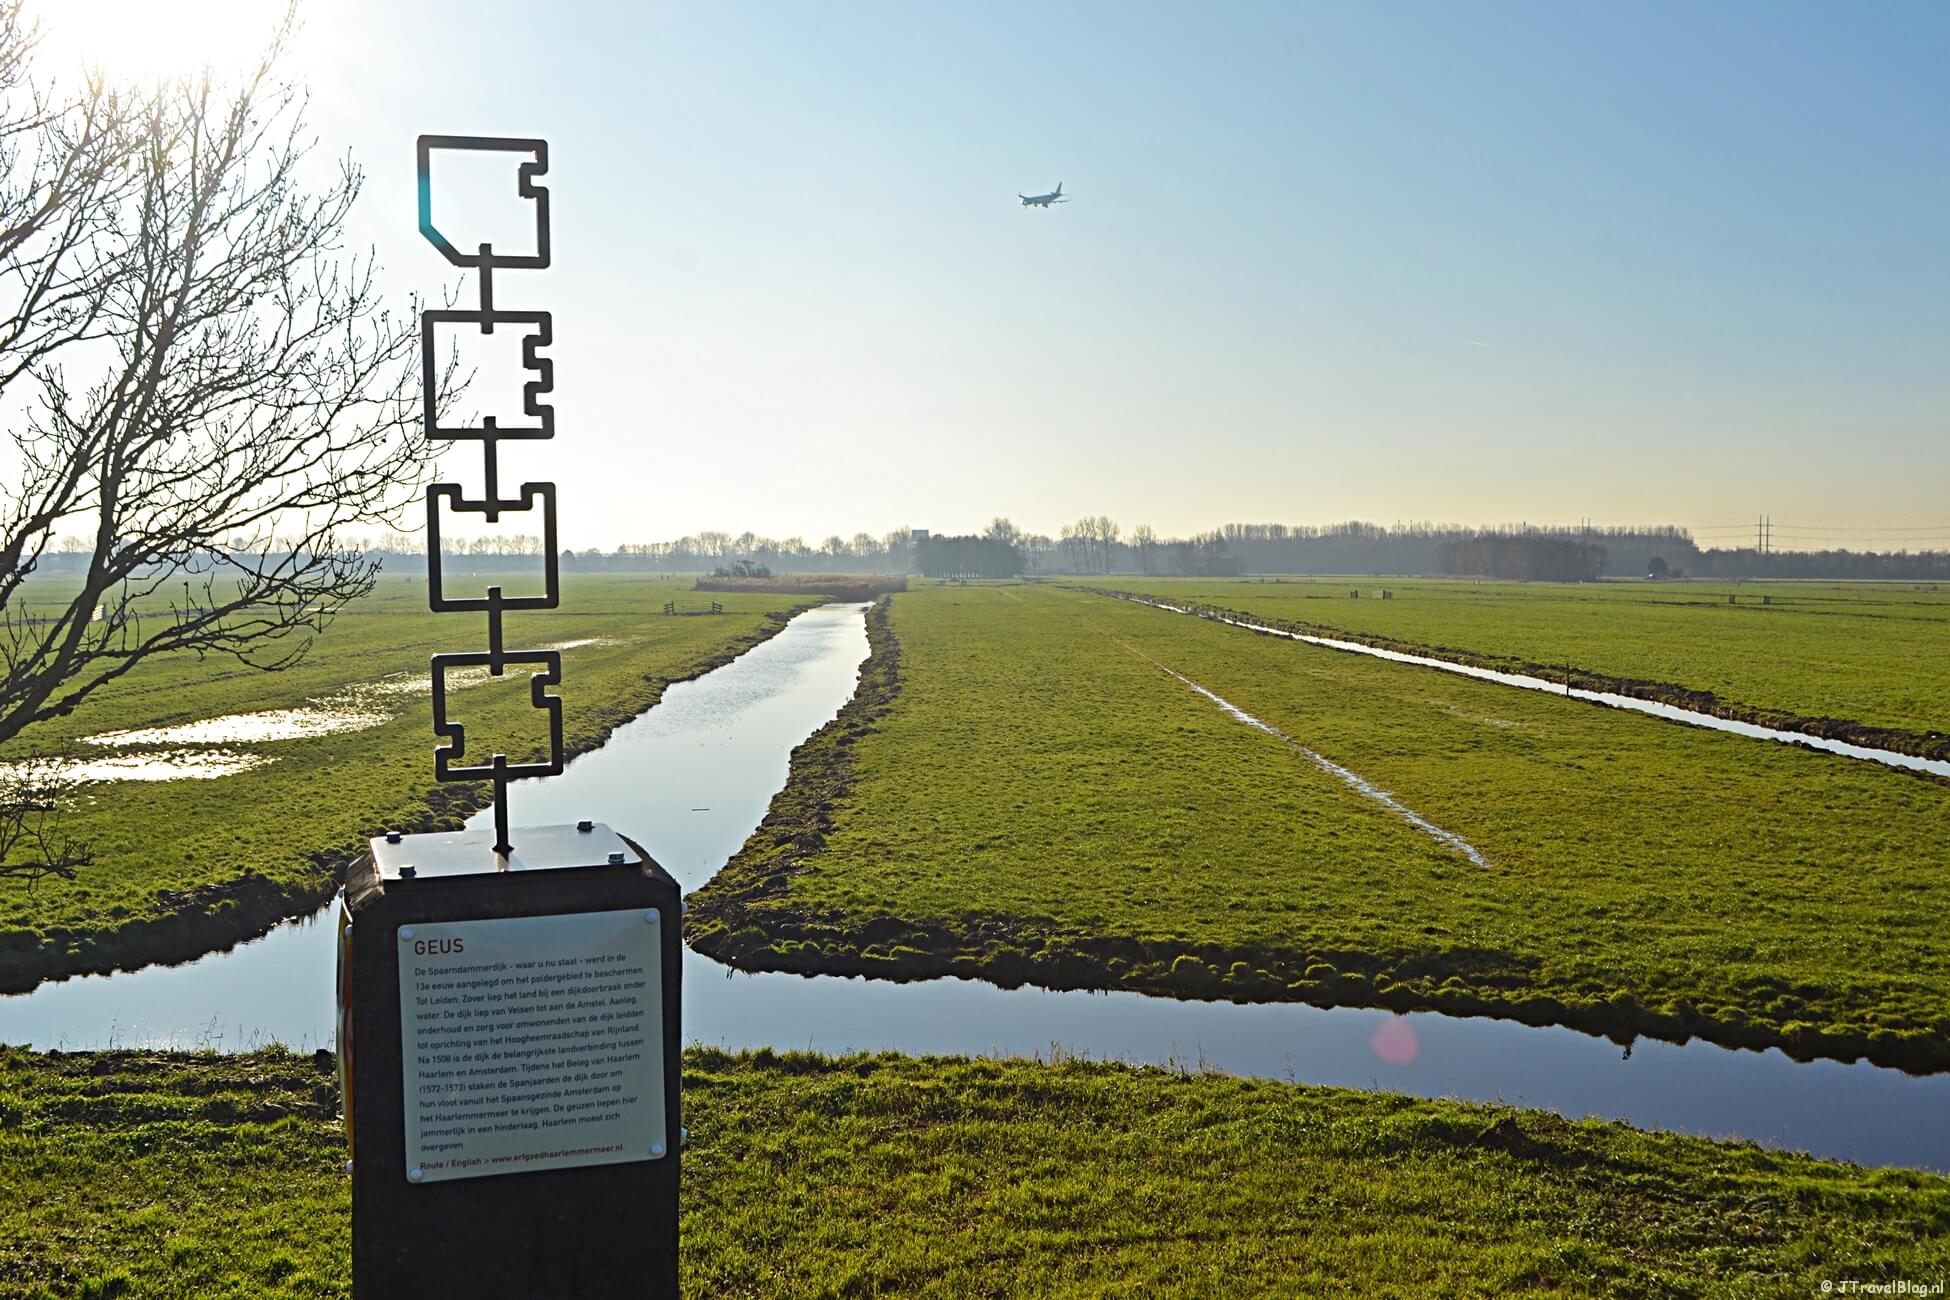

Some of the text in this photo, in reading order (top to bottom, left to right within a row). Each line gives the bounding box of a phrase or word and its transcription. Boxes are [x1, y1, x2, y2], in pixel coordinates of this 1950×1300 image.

[415, 938, 463, 955] GEUS
[415, 968, 426, 976] De
[428, 962, 507, 976] Spaarndammerdijk
[558, 958, 577, 966] staat
[585, 954, 605, 964] werd
[607, 954, 614, 962] in
[616, 953, 626, 961] de
[416, 982, 430, 990] 13e
[456, 977, 498, 989] aangelegd
[516, 976, 529, 984] het
[531, 971, 583, 985] poldergebied
[417, 997, 427, 1005] Tot
[462, 994, 485, 1003] Zover
[487, 993, 502, 1002] liep
[519, 989, 536, 998] land
[539, 989, 548, 998] bij
[568, 983, 621, 996] dijkdoorbraak
[624, 980, 646, 989] onder
[443, 1010, 455, 1019] De
[457, 1009, 472, 1019] dijk
[474, 1008, 489, 1017] liep
[507, 1006, 534, 1014] Velsen
[536, 1004, 547, 1012] tot
[566, 1001, 575, 1010] de
[417, 1025, 462, 1034] onderhoud
[476, 1024, 494, 1032] zorg
[516, 1017, 570, 1028] omwonenden
[588, 1014, 598, 1022] de
[600, 1013, 614, 1021] dijk
[430, 1040, 471, 1050] oprichting
[490, 1036, 503, 1045] het
[505, 1030, 589, 1044] Hoogheemraadschap
[418, 1056, 430, 1064] Na
[462, 1054, 472, 1062] de
[475, 1052, 489, 1061] dijk
[492, 1052, 501, 1060] de
[504, 1048, 556, 1058] belangrijkste
[558, 1041, 616, 1054] landverbinding
[618, 1039, 643, 1048] tussen
[419, 1070, 454, 1078] Haarlem
[521, 1063, 549, 1072] Tijdens
[552, 1060, 564, 1069] het
[567, 1059, 589, 1068] Beleg
[591, 1056, 605, 1064] van
[607, 1054, 640, 1064] Haarlem
[468, 1082, 495, 1090] staken
[497, 1080, 507, 1088] de
[510, 1076, 560, 1088] Spanjaarden
[574, 1073, 588, 1082] dijk
[420, 1084, 621, 1108] hun vloot vanuit het Spaansgezinde Amsterdam op
[435, 1110, 509, 1121] Haarlemmermeer
[511, 1108, 518, 1116] te
[554, 1104, 564, 1112] De
[566, 1102, 595, 1112] geuzen
[597, 1099, 620, 1108] liepen
[622, 1096, 637, 1104] hier
[420, 1127, 465, 1139] jammerlijk
[468, 1126, 475, 1134] in
[542, 1118, 576, 1127] Haarlem
[579, 1114, 603, 1123] moest
[604, 1112, 620, 1120] zich
[420, 1161, 443, 1169] Route
[452, 1158, 481, 1168] English
